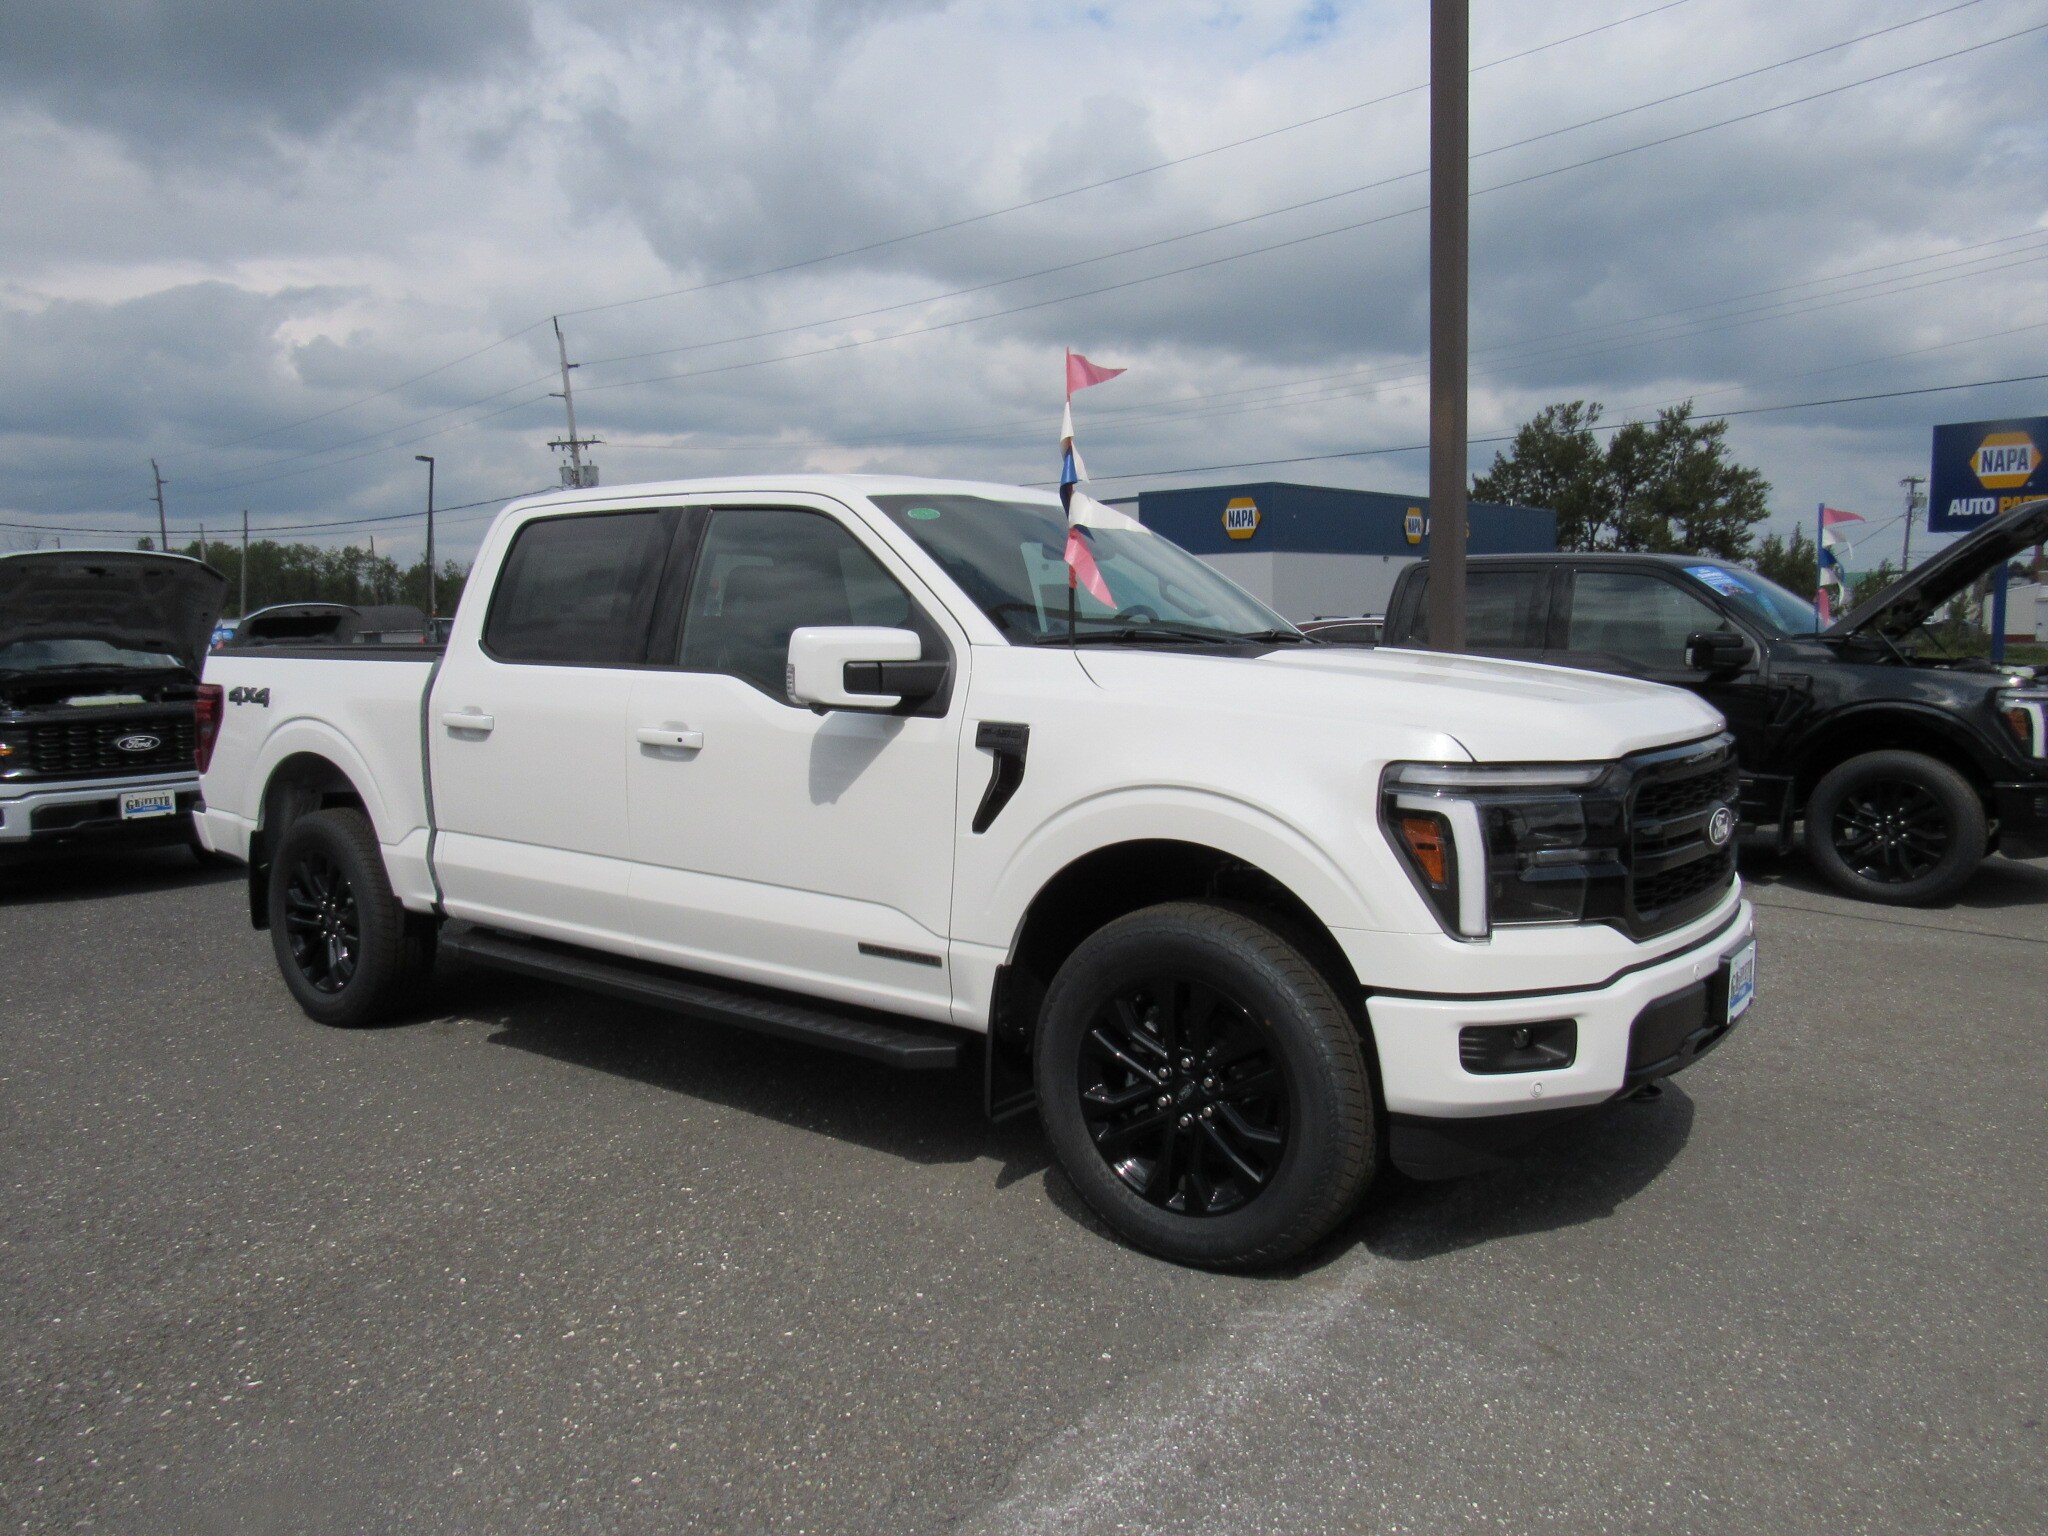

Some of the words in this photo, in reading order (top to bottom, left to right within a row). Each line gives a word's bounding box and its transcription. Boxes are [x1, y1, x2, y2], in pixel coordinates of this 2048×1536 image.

[1980, 447, 2029, 473] NAPA
[1947, 497, 1996, 516] AUTO
[1228, 509, 1254, 528] NAPA
[1407, 516, 1421, 534] NAPA
